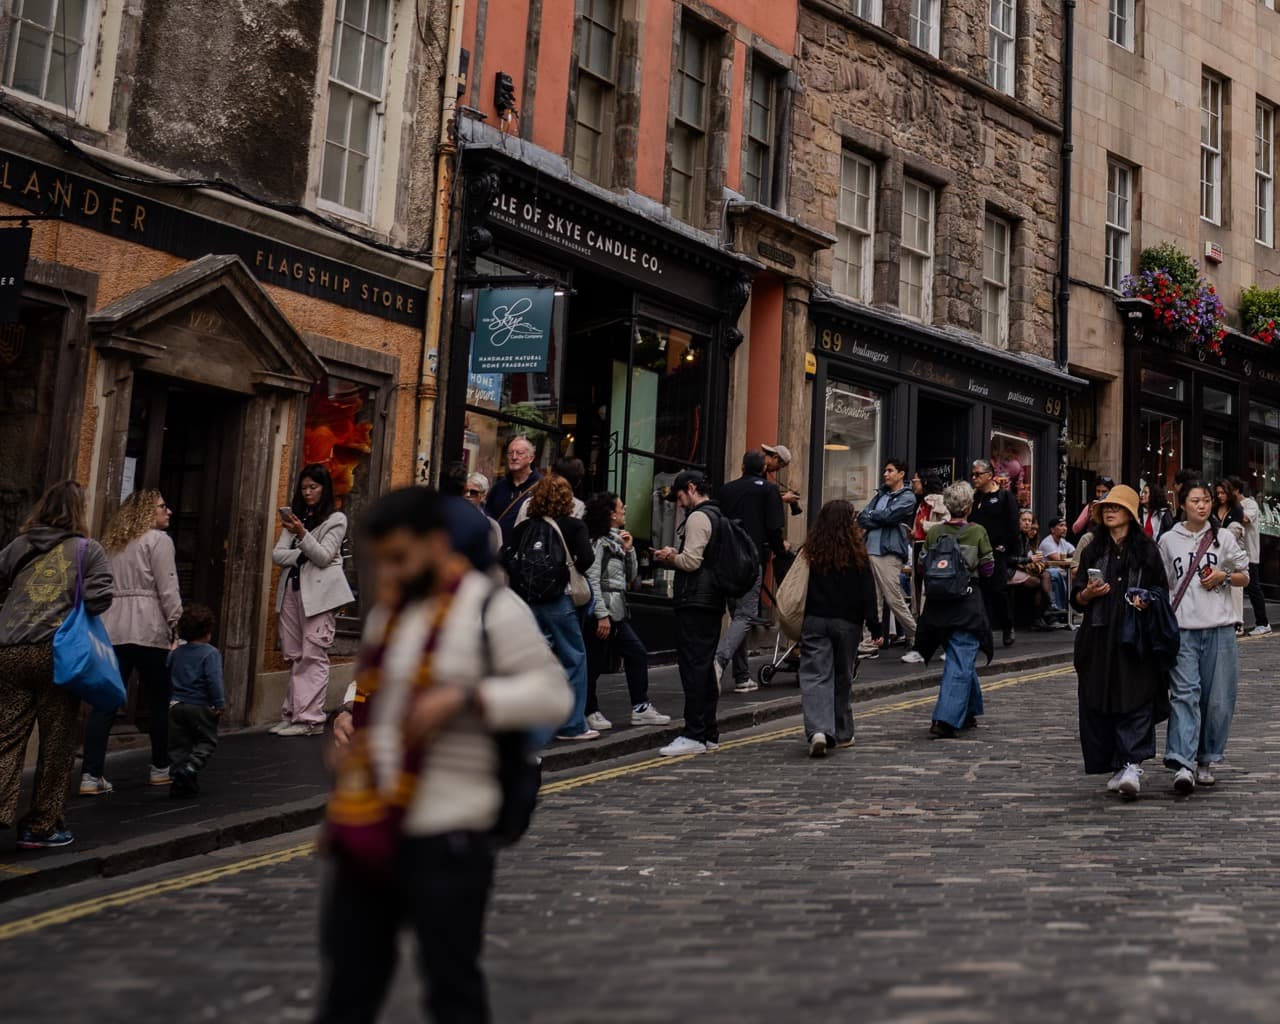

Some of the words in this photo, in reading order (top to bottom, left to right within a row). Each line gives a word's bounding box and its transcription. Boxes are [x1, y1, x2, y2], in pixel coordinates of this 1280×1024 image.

[492, 193, 518, 215] SLE
[523, 203, 542, 224] OF
[547, 213, 582, 241] SKYE
[586, 229, 638, 264] CANDLE
[641, 252, 663, 274] CO.
[256, 248, 351, 294] FLAGSHIP
[361, 283, 415, 314] STORE
[479, 355, 513, 363] HANDMADE
[514, 354, 542, 362] NATURAL
[821, 328, 842, 352] 89
[852, 339, 890, 364] boulangerie
[470, 373, 494, 388] HOME
[1045, 398, 1062, 417] 89
